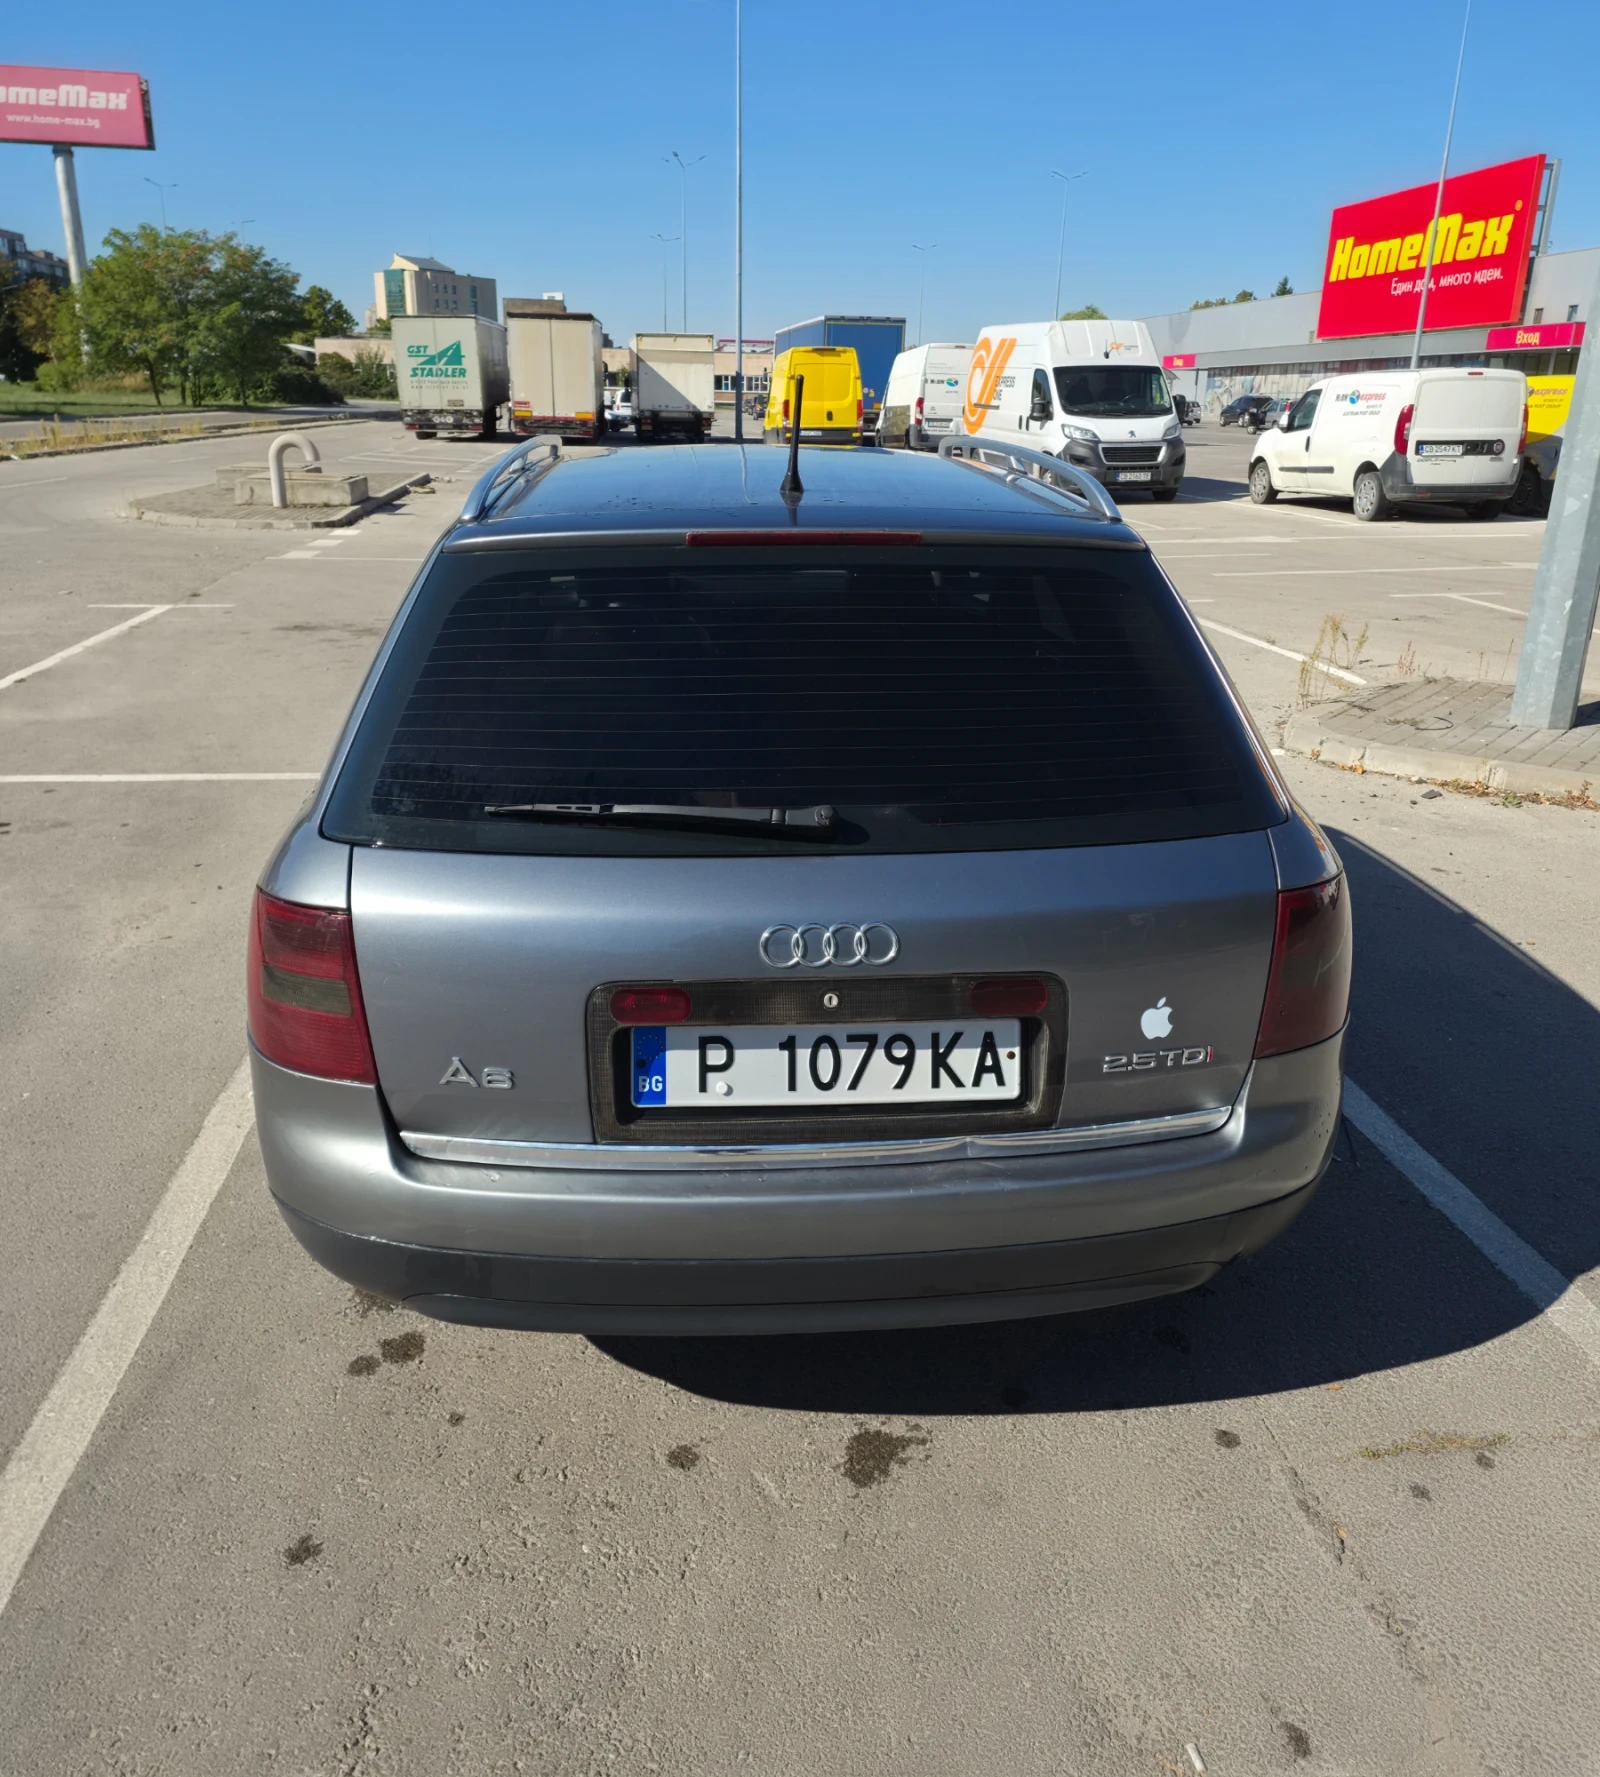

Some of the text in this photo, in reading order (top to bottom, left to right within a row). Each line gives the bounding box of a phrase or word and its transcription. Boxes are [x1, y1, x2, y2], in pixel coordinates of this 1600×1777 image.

[6, 114, 100, 129] www.home-max.bg
[1328, 213, 1514, 283] HomeMax
[1391, 277, 1413, 296] Един
[1439, 272, 1471, 287] много
[1473, 267, 1503, 285] идеи.
[1515, 330, 1540, 345] Вход
[407, 345, 429, 354] GST
[410, 367, 467, 378] STADLER
[1360, 392, 1386, 403] express
[1534, 388, 1568, 397] express
[697, 1036, 735, 1093] P
[778, 1034, 916, 1092] 1079
[1159, 1045, 1214, 1067] TDI
[439, 1056, 517, 1090] A6
[638, 1075, 663, 1093] BG
